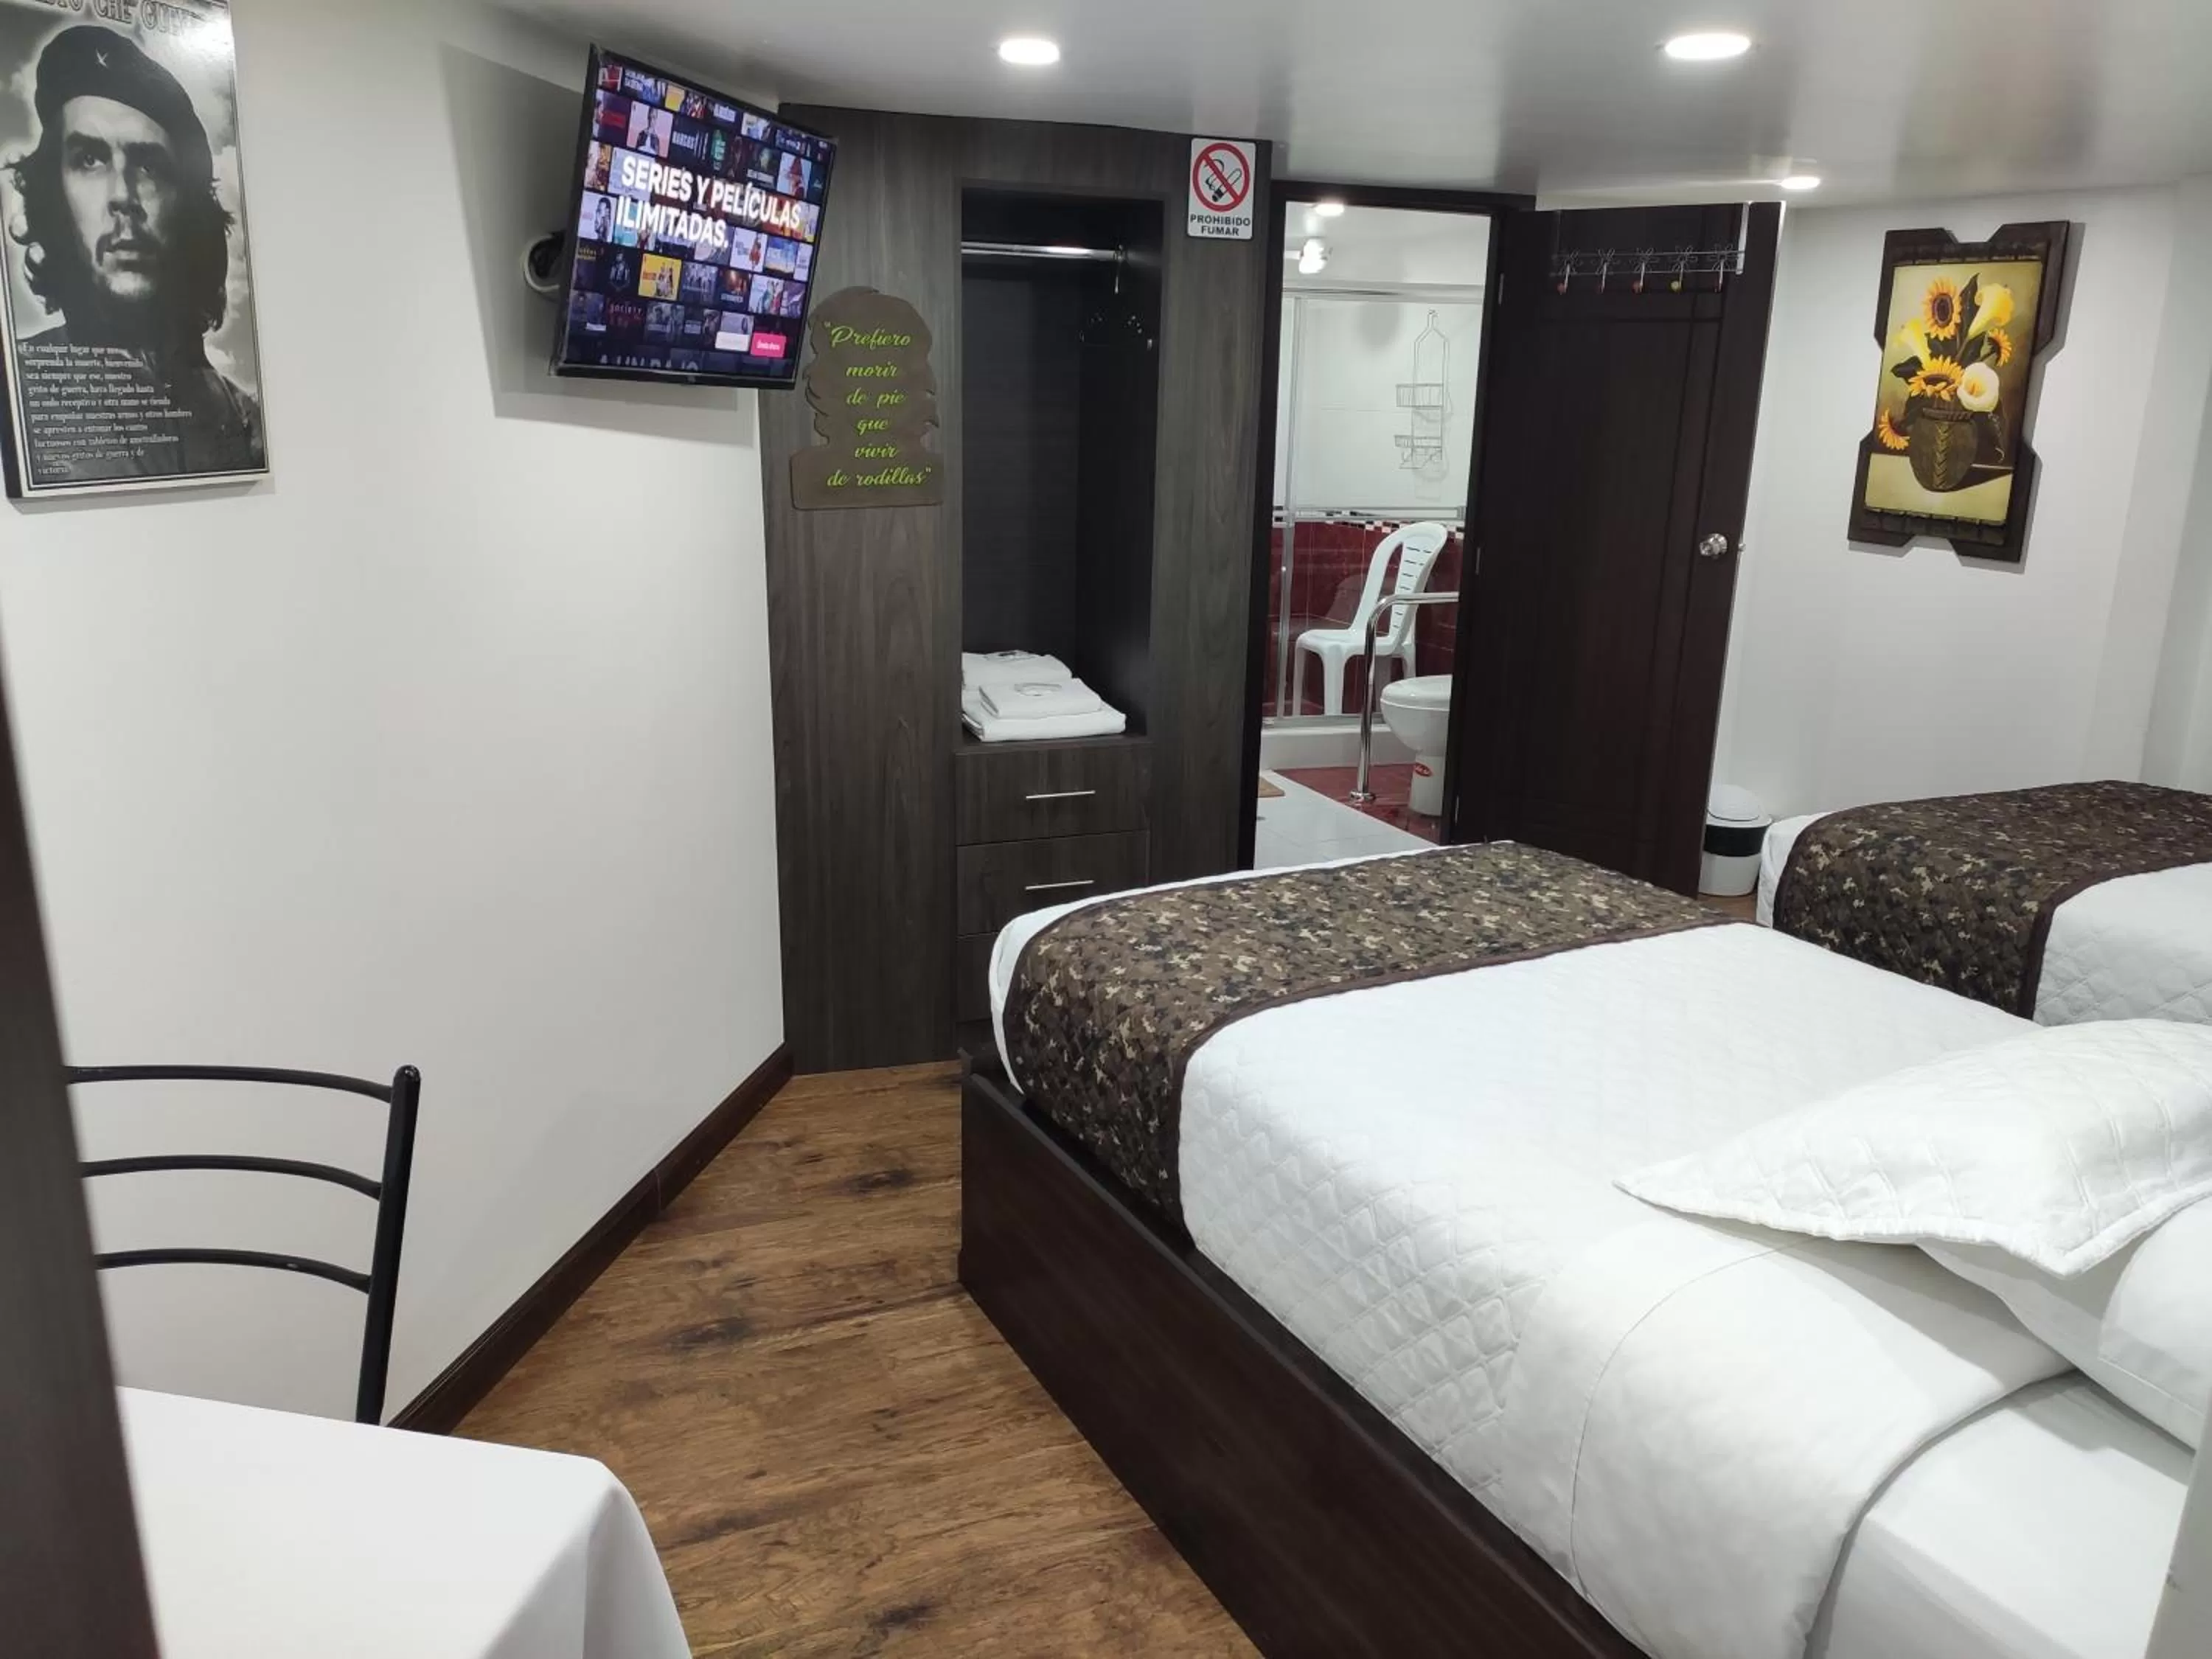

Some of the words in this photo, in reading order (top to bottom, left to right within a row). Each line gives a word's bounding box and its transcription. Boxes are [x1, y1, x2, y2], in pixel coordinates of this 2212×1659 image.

[622, 155, 693, 202] SERIES
[698, 174, 712, 205] Y
[710, 178, 801, 230] PELÍCULAS
[616, 195, 728, 248] ILIMITADAS.
[1190, 214, 1251, 226] PROHIBIDO
[1201, 226, 1239, 236] FUMAR
[846, 361, 899, 377] morir
[846, 386, 867, 405] de
[877, 389, 906, 408] pie
[858, 418, 888, 436] que
[855, 443, 900, 458] vivir
[827, 470, 849, 487] de
